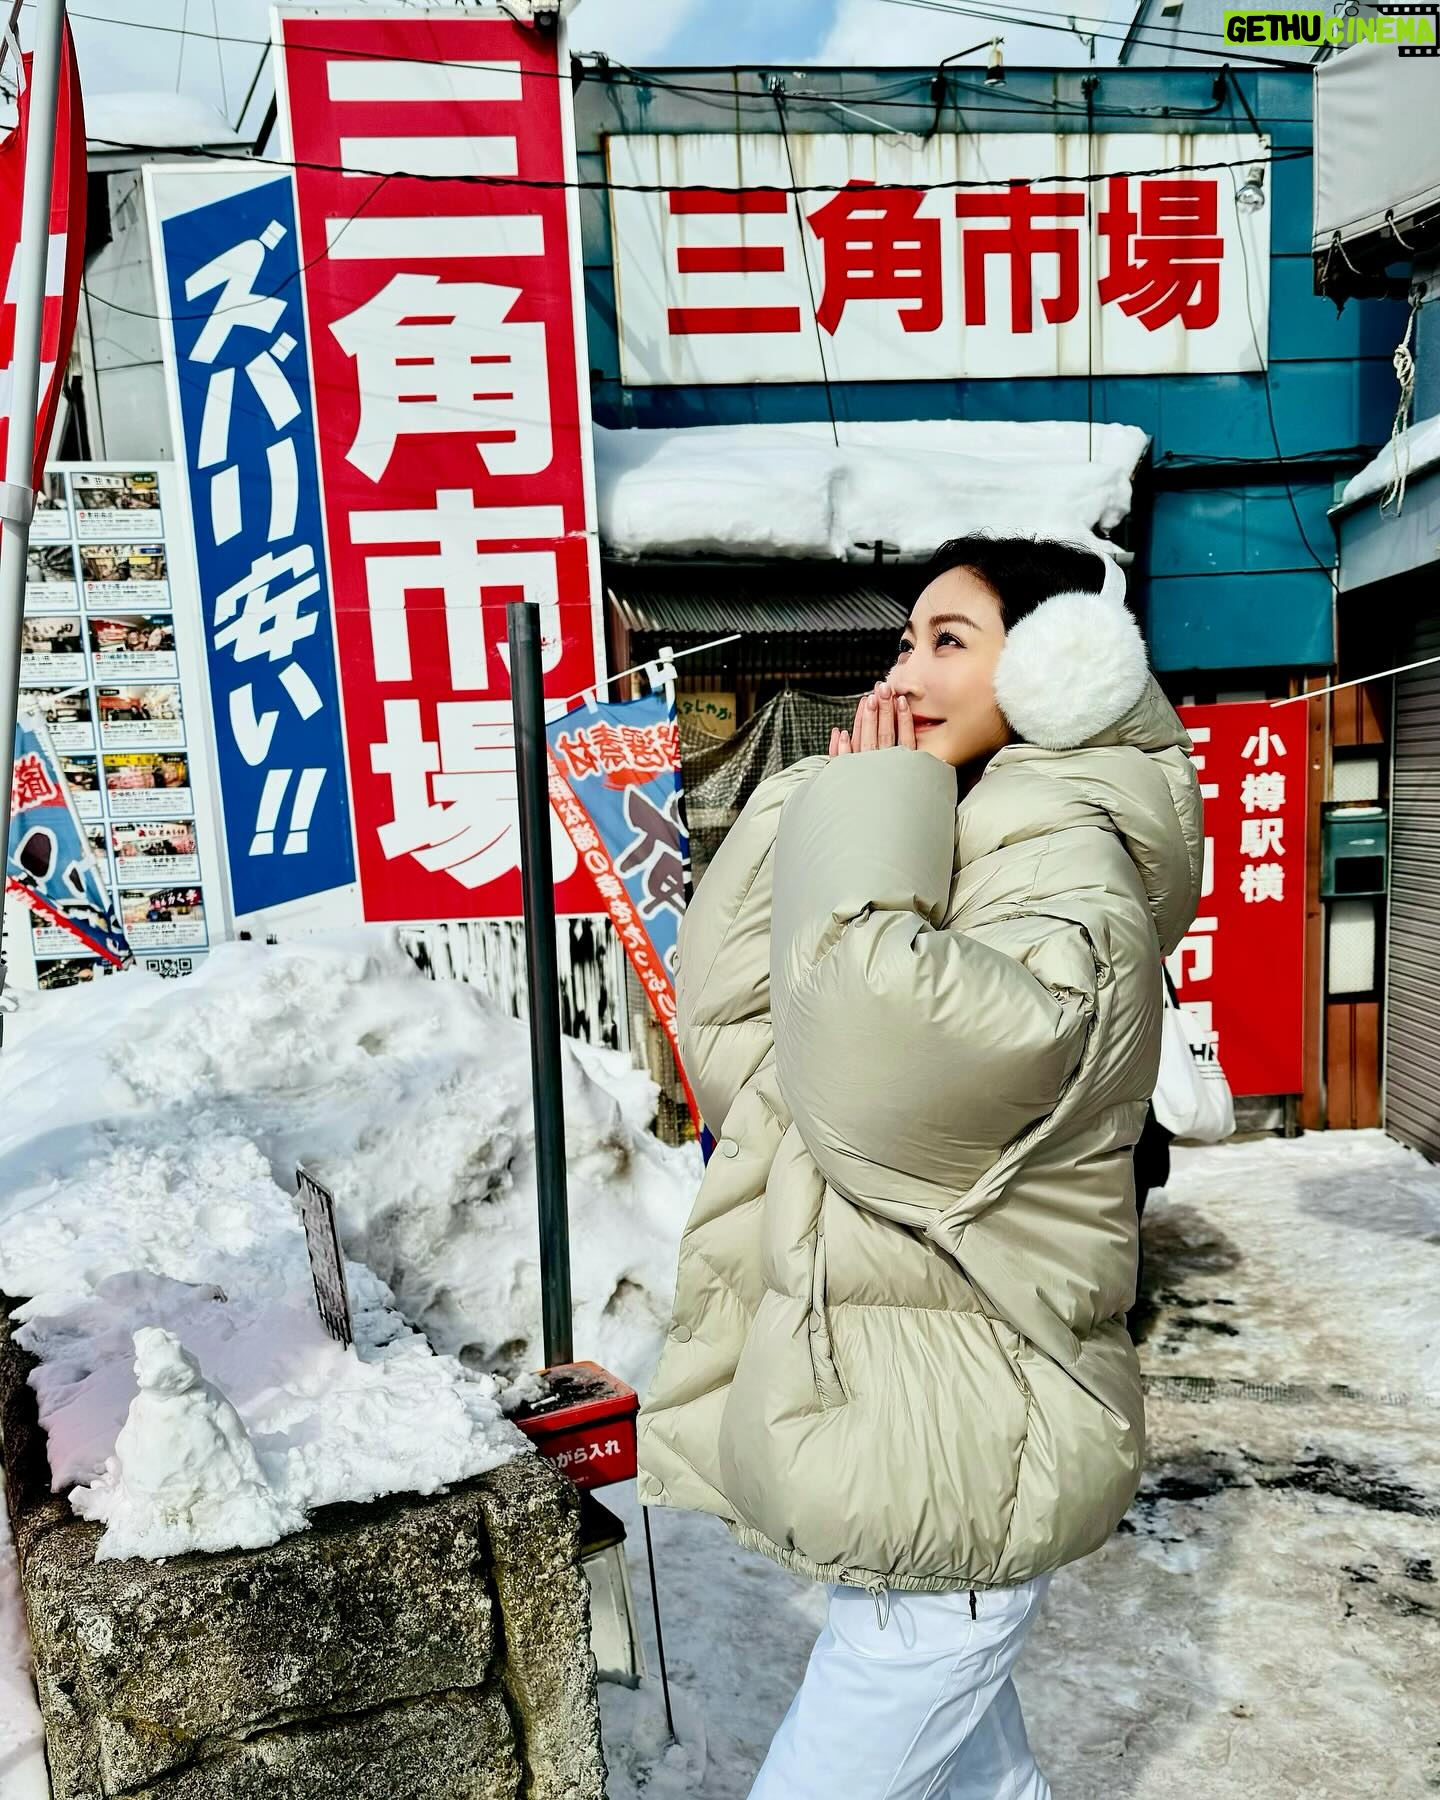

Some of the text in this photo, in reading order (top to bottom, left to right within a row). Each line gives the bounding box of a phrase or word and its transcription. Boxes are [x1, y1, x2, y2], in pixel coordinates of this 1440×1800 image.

[667, 177, 1225, 336] 三角市場
[324, 60, 579, 890] 三角市場
[1239, 726, 1288, 904] 小樽駅横
